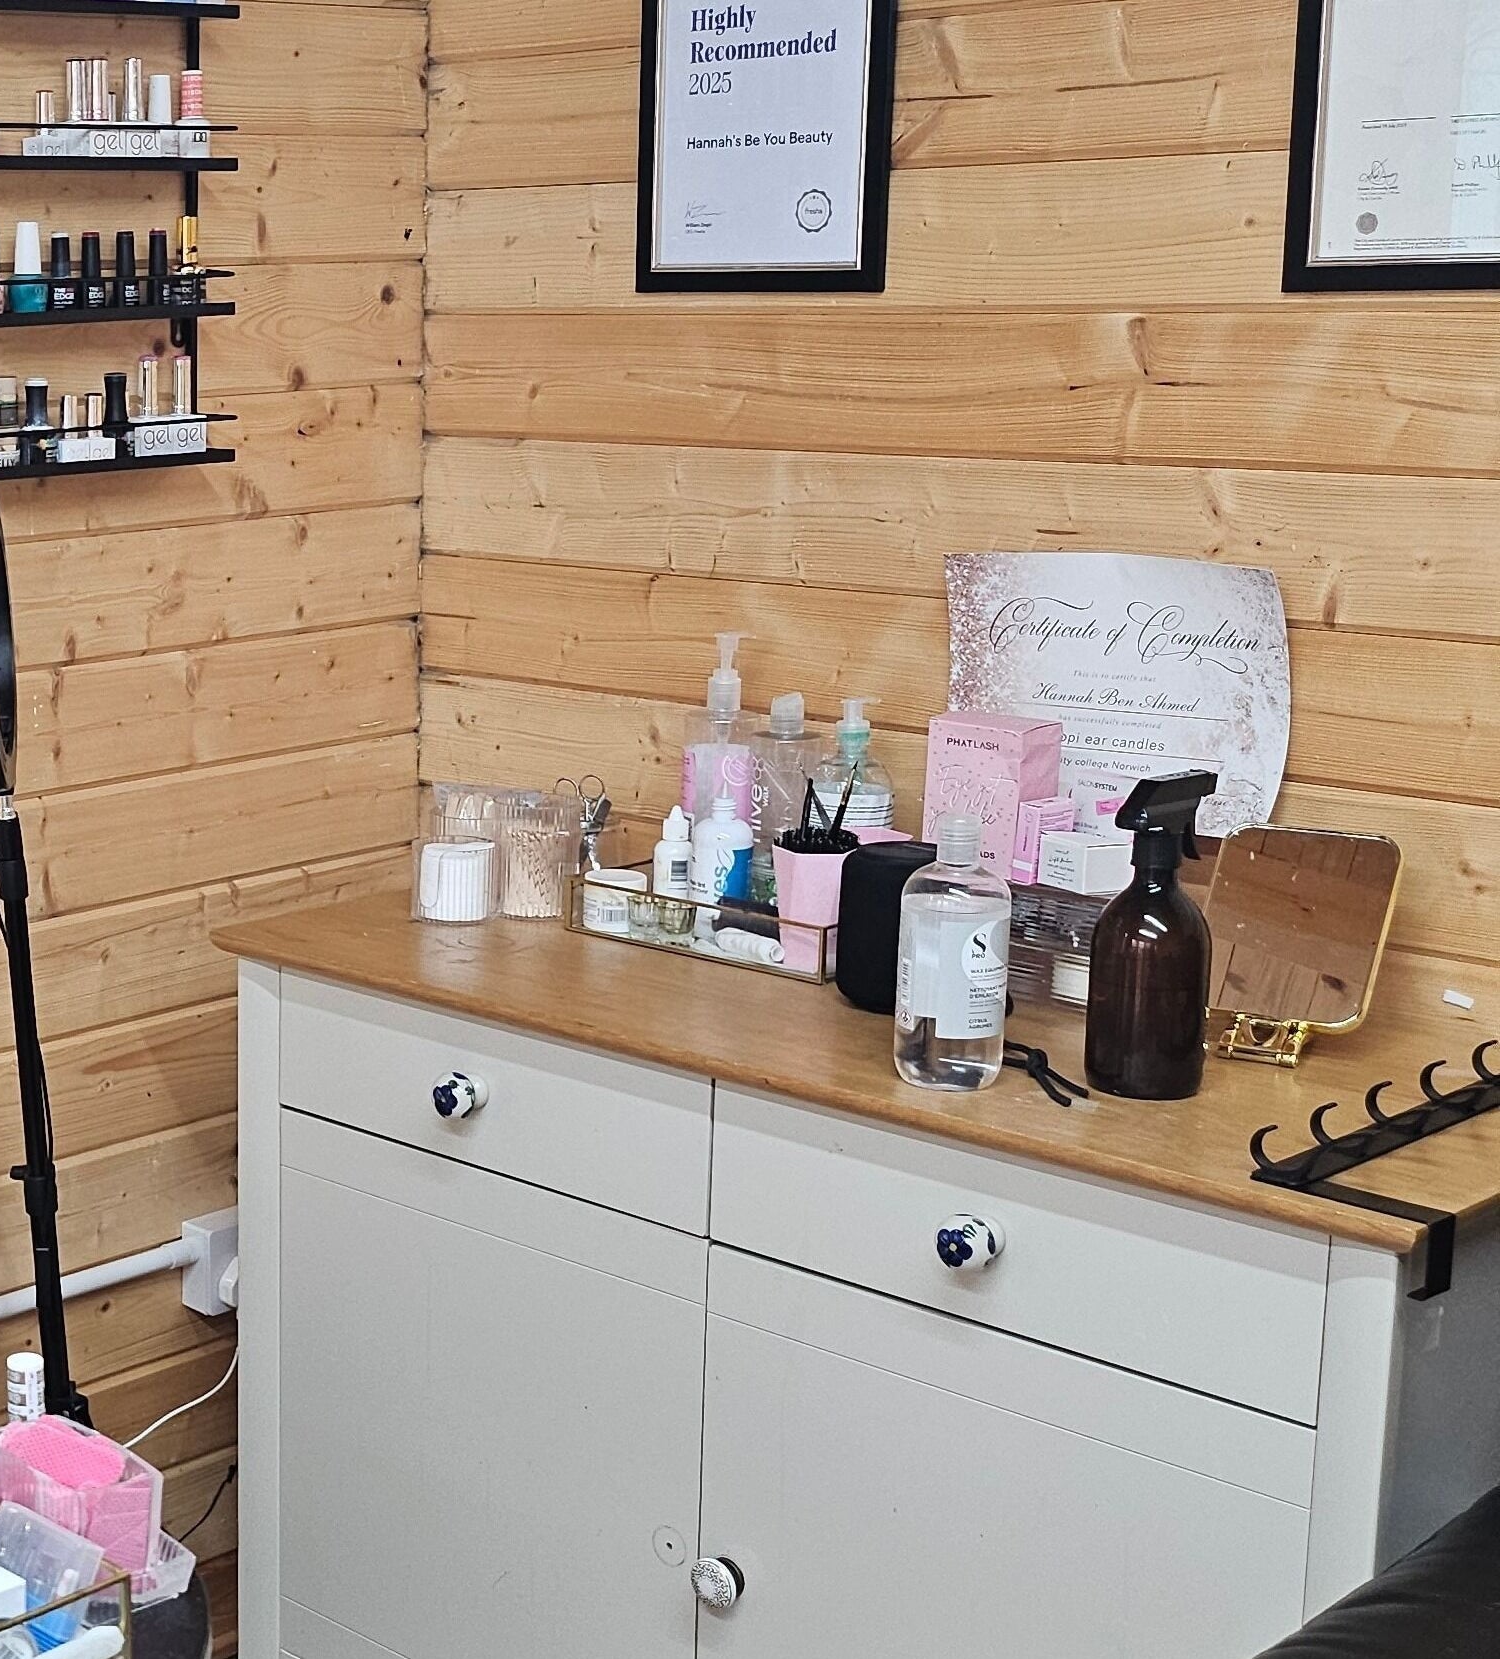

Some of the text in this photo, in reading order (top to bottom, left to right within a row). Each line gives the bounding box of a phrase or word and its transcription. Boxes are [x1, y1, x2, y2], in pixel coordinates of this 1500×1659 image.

[691, 4, 757, 35] Highly
[690, 29, 837, 64] Recommended
[689, 72, 732, 96] 2025
[94, 130, 124, 156] gel
[130, 131, 160, 156] gel
[687, 130, 833, 150] Hannah's Be You Beauty
[144, 425, 204, 450] gel gel
[985, 597, 1261, 674] Certificate of Completion
[1032, 682, 1201, 712] Hannah Ben Ahmed
[1074, 716, 1119, 726] successfully
[1122, 720, 1162, 730] completed
[1084, 736, 1107, 746] ear
[1112, 738, 1166, 752] candles
[1074, 759, 1110, 770] college
[1112, 761, 1152, 772] Norwich
